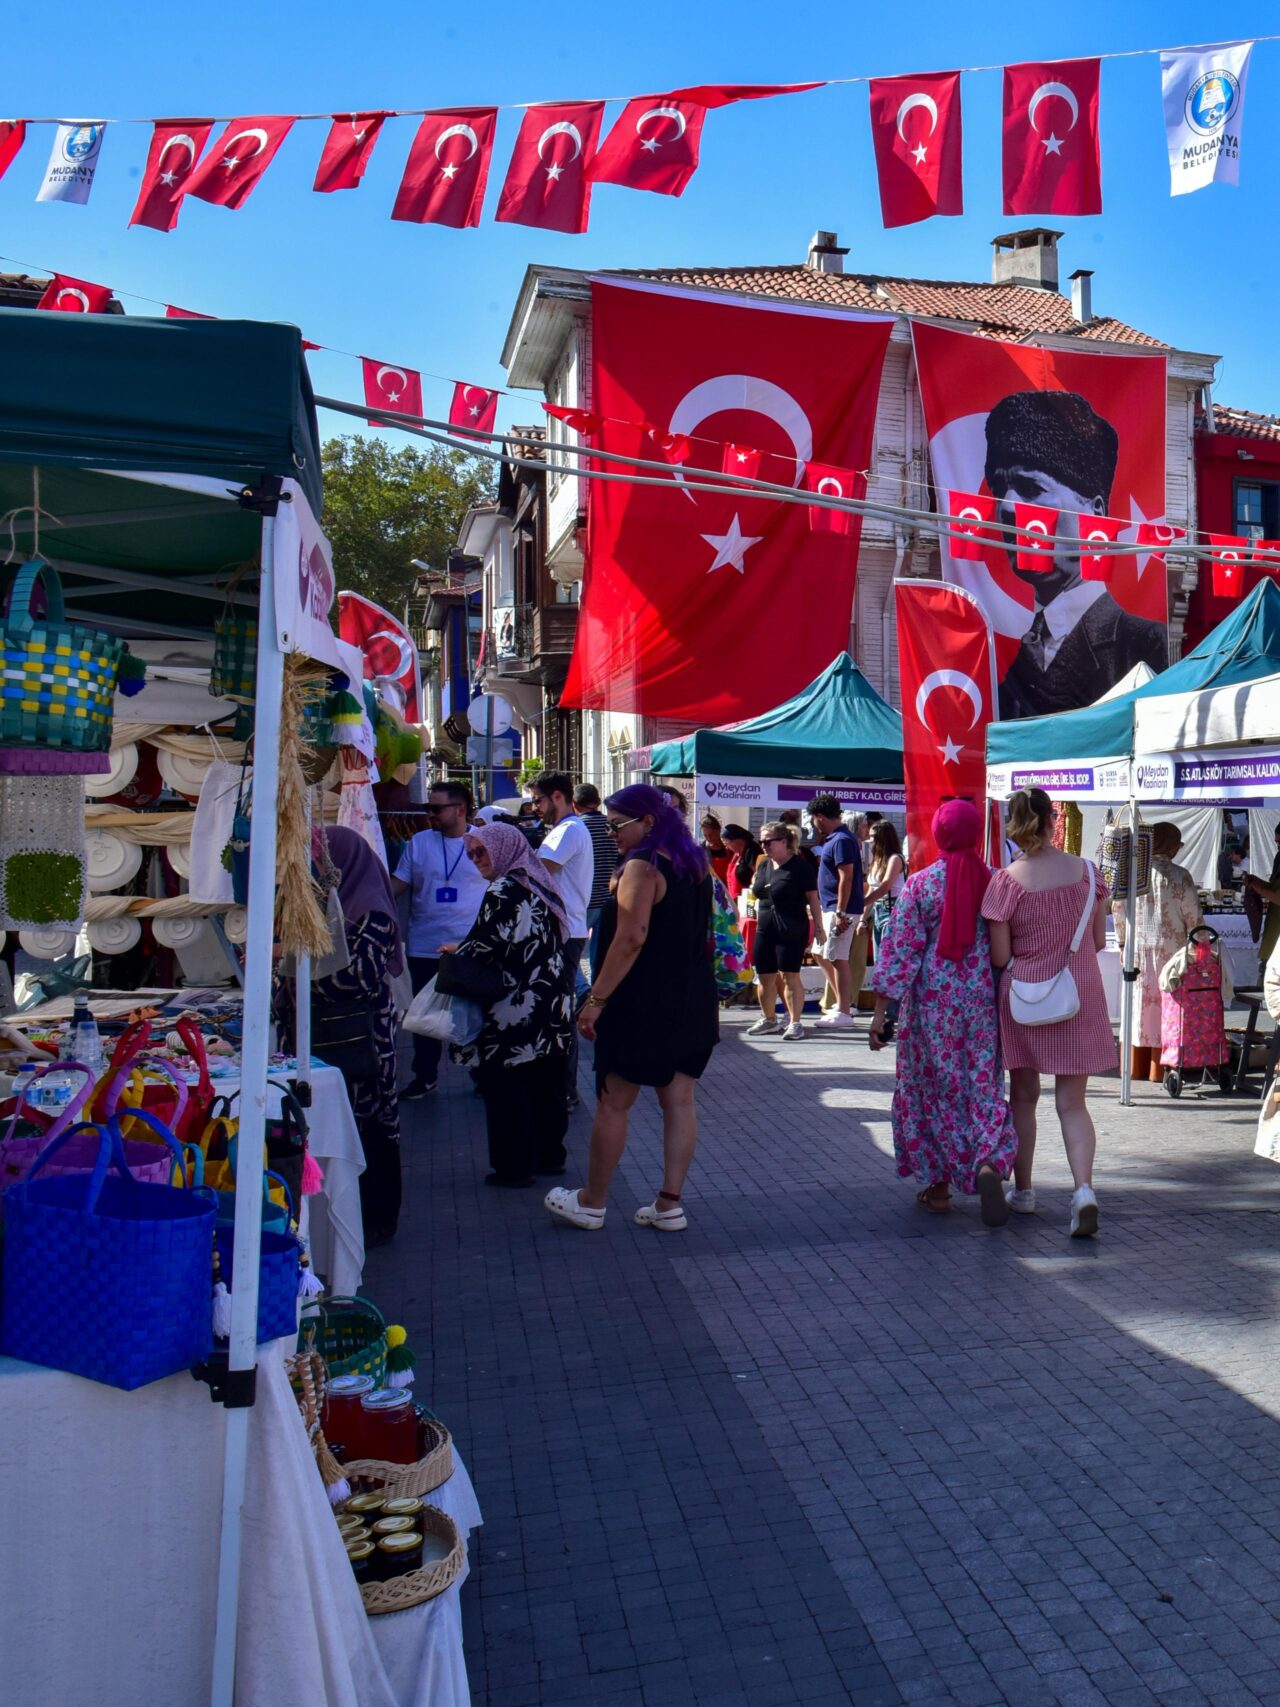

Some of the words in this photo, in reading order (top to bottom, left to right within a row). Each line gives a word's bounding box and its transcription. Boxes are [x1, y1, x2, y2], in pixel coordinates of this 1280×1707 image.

[1183, 135, 1238, 160] MUDANYA
[1223, 764, 1255, 780] TARIMSAL
[717, 782, 761, 794] Meydan
[717, 790, 761, 800] Kadınların
[861, 791, 882, 801] KAD.
